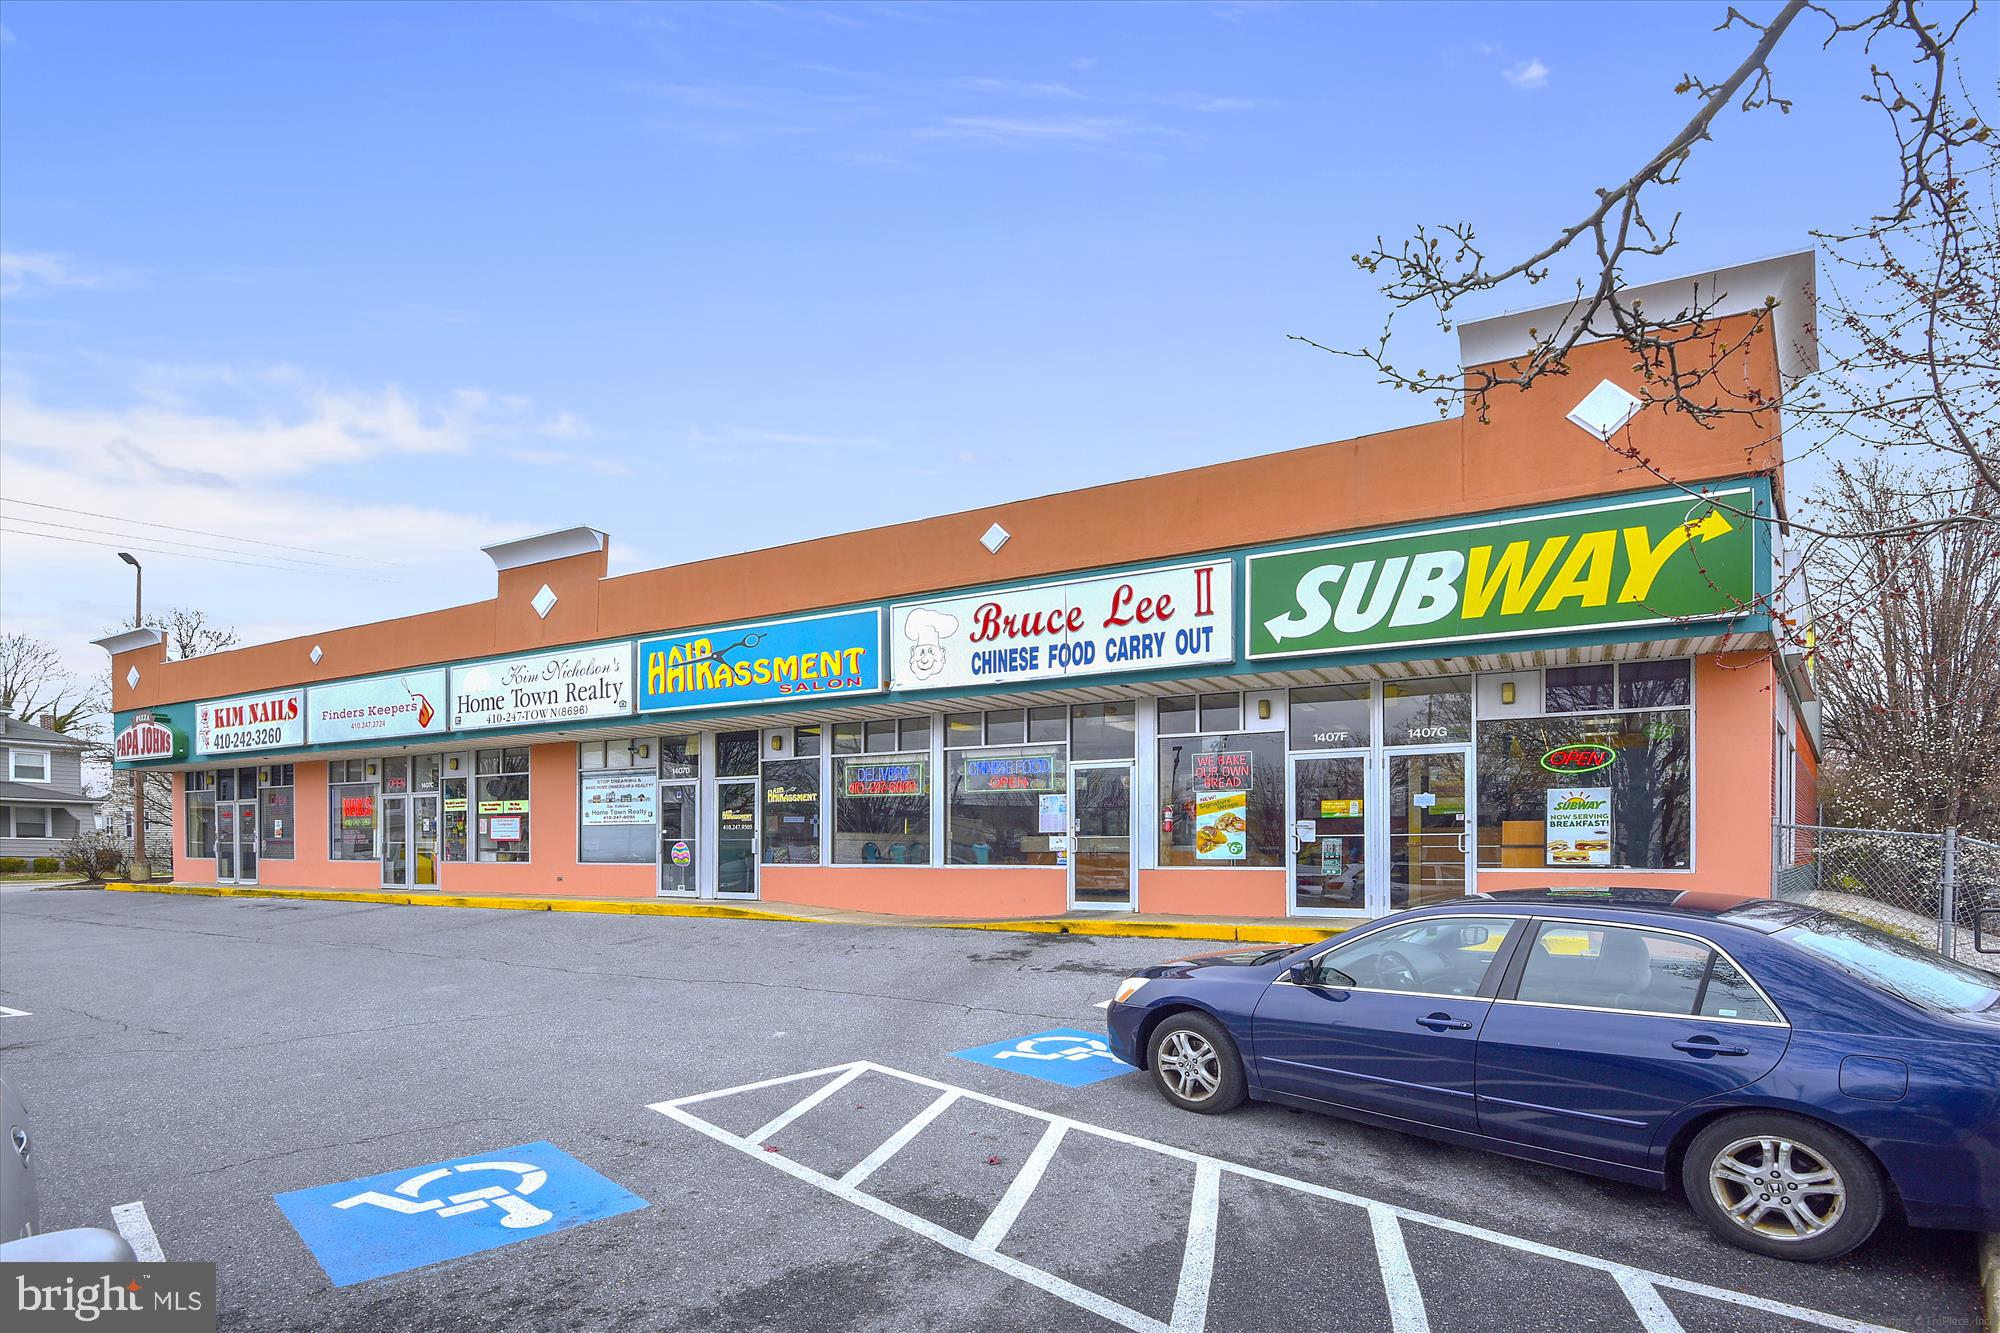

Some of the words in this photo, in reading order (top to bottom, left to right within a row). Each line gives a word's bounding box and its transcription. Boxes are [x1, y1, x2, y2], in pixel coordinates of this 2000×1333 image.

[1264, 509, 1733, 644] SUBWAY
[969, 602, 1085, 643] Bruce
[1102, 584, 1176, 629] Lee
[1194, 567, 1214, 617] II
[971, 645, 1039, 675] CHINESE
[1048, 640, 1095, 668] FOOD
[1105, 631, 1166, 663] CARRY
[1175, 625, 1214, 655] OUT
[501, 663, 539, 686] Kim
[542, 657, 620, 681] Nicholson's
[779, 676, 862, 694] SALON
[457, 694, 505, 714] Home
[511, 688, 558, 708] Town
[565, 677, 624, 704] Realty
[135, 714, 150, 722] PIZZA
[214, 706, 244, 729] KIM
[248, 696, 299, 725] NAILS
[321, 709, 365, 721] Finders
[368, 703, 417, 717] Keepers
[351, 720, 386, 730] 410.247.2724
[1408, 727, 1448, 738] 1407G
[116, 729, 139, 757] PAPA
[214, 727, 282, 750] 410-242-3260
[1312, 731, 1348, 742] 1407F
[1197, 756, 1215, 767] WE
[1218, 754, 1247, 766] BAKE
[1549, 751, 1607, 766] OPEN
[672, 767, 691, 775] 1407D
[857, 767, 909, 782] DELIVERY
[968, 759, 1014, 776] CHINESE
[1015, 758, 1050, 775] FOOD
[1195, 767, 1219, 778] OUR
[1222, 766, 1249, 777] OWN
[989, 776, 1029, 789] OPEN
[1204, 777, 1242, 788] BREAD
[343, 796, 372, 817] NAILS
[1553, 800, 1607, 811] SUBWAY
[1550, 820, 1610, 828] BREAKFAST!
